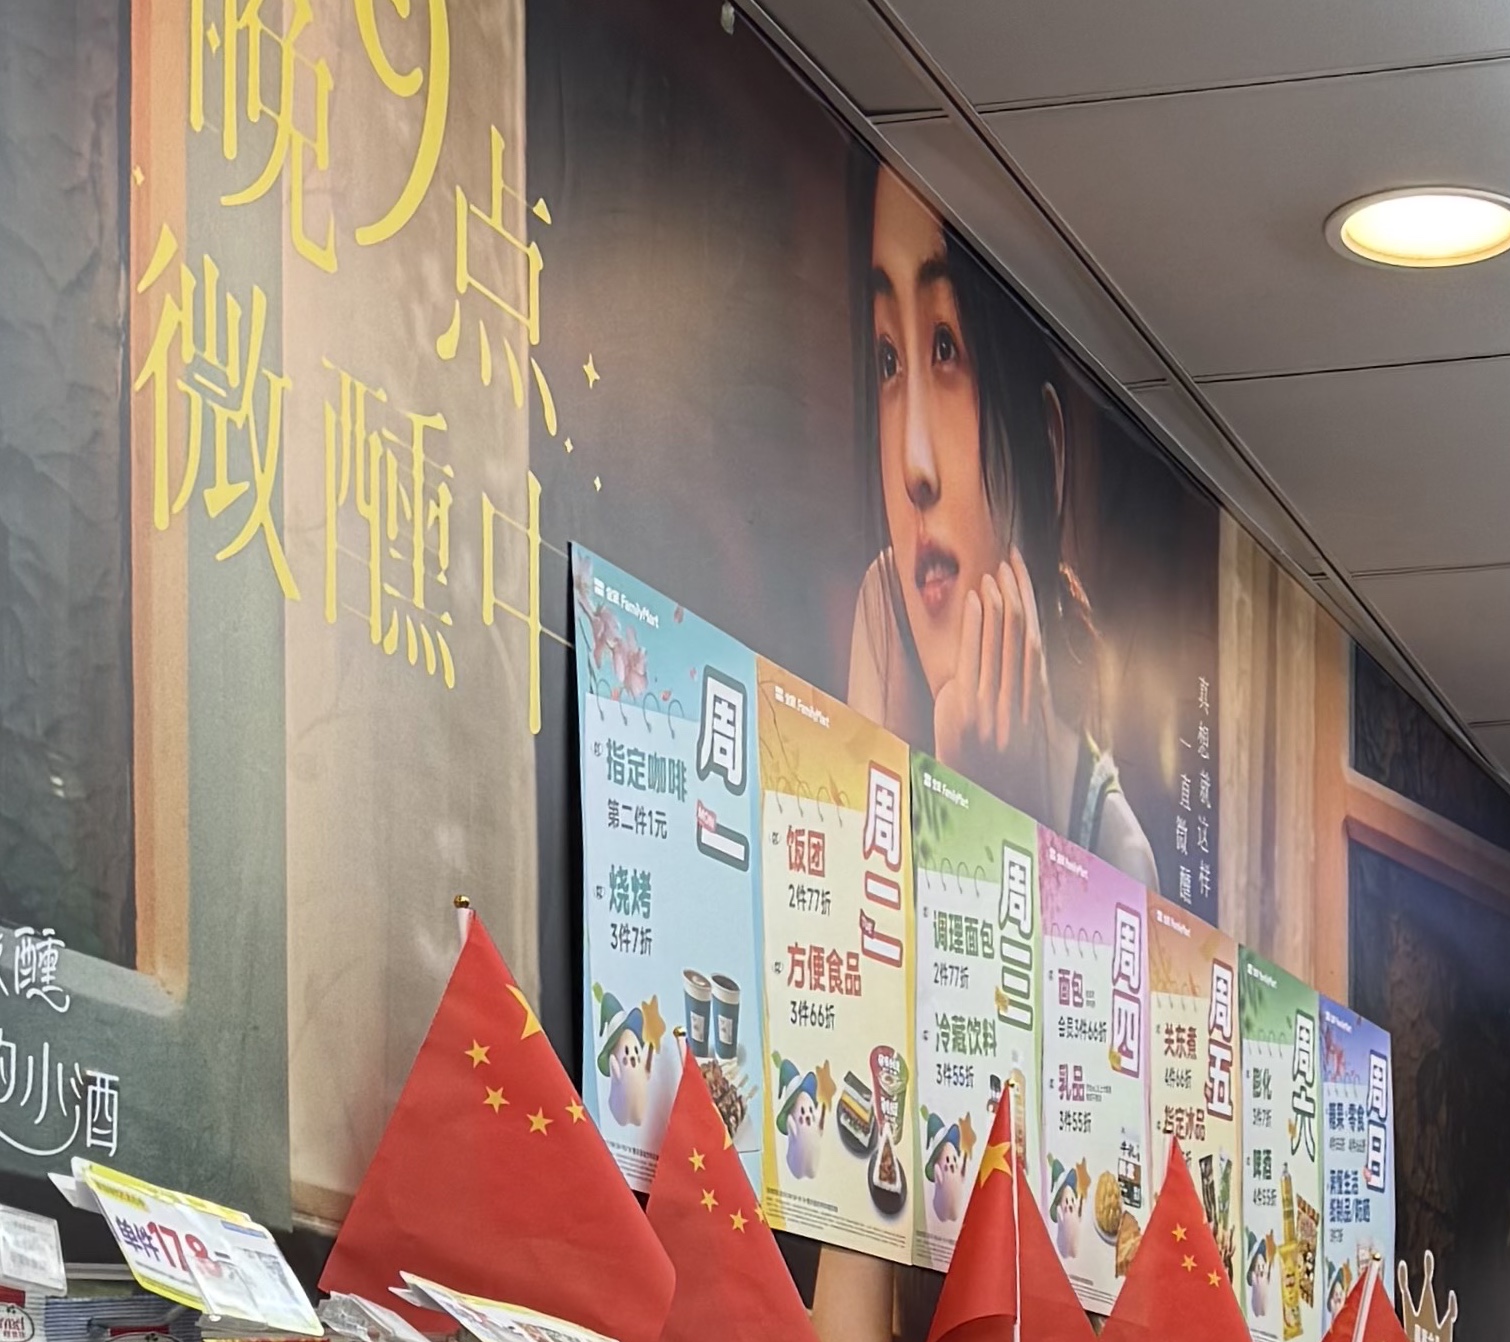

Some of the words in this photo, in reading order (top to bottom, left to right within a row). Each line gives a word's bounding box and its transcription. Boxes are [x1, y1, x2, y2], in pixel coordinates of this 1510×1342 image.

[621, 592, 660, 629] FamilyMart
[606, 739, 688, 803] 指定咖啡
[698, 665, 749, 872] 周一
[1196, 675, 1212, 899] 真想就这样
[607, 799, 668, 840] 第二件1元
[1175, 736, 1193, 906] 一直微醺
[786, 825, 826, 878] 饭团
[860, 760, 904, 968] 周二
[609, 865, 652, 920] 烧烤
[788, 885, 831, 917] 2件77折
[610, 926, 653, 956] 3件7折
[933, 910, 995, 959] 调理面包
[999, 839, 1033, 1031] 周三
[787, 943, 862, 997] 方便食品
[933, 962, 969, 990] 2件77折
[1058, 969, 1084, 1008] 面包
[1112, 902, 1142, 1078] 周四
[790, 1001, 835, 1030] 3件66折
[935, 1013, 997, 1057] 冷藏饮料
[1207, 958, 1233, 1121] 周五
[1164, 1023, 1197, 1060] 关东煮
[936, 1063, 974, 1089] 3件55折
[1058, 1064, 1085, 1101] 乳品
[1291, 1009, 1316, 1162] 周六
[1059, 1111, 1092, 1133] 3件55折
[1367, 1050, 1388, 1193] 周日
[1253, 1150, 1272, 1180] 啤酒
